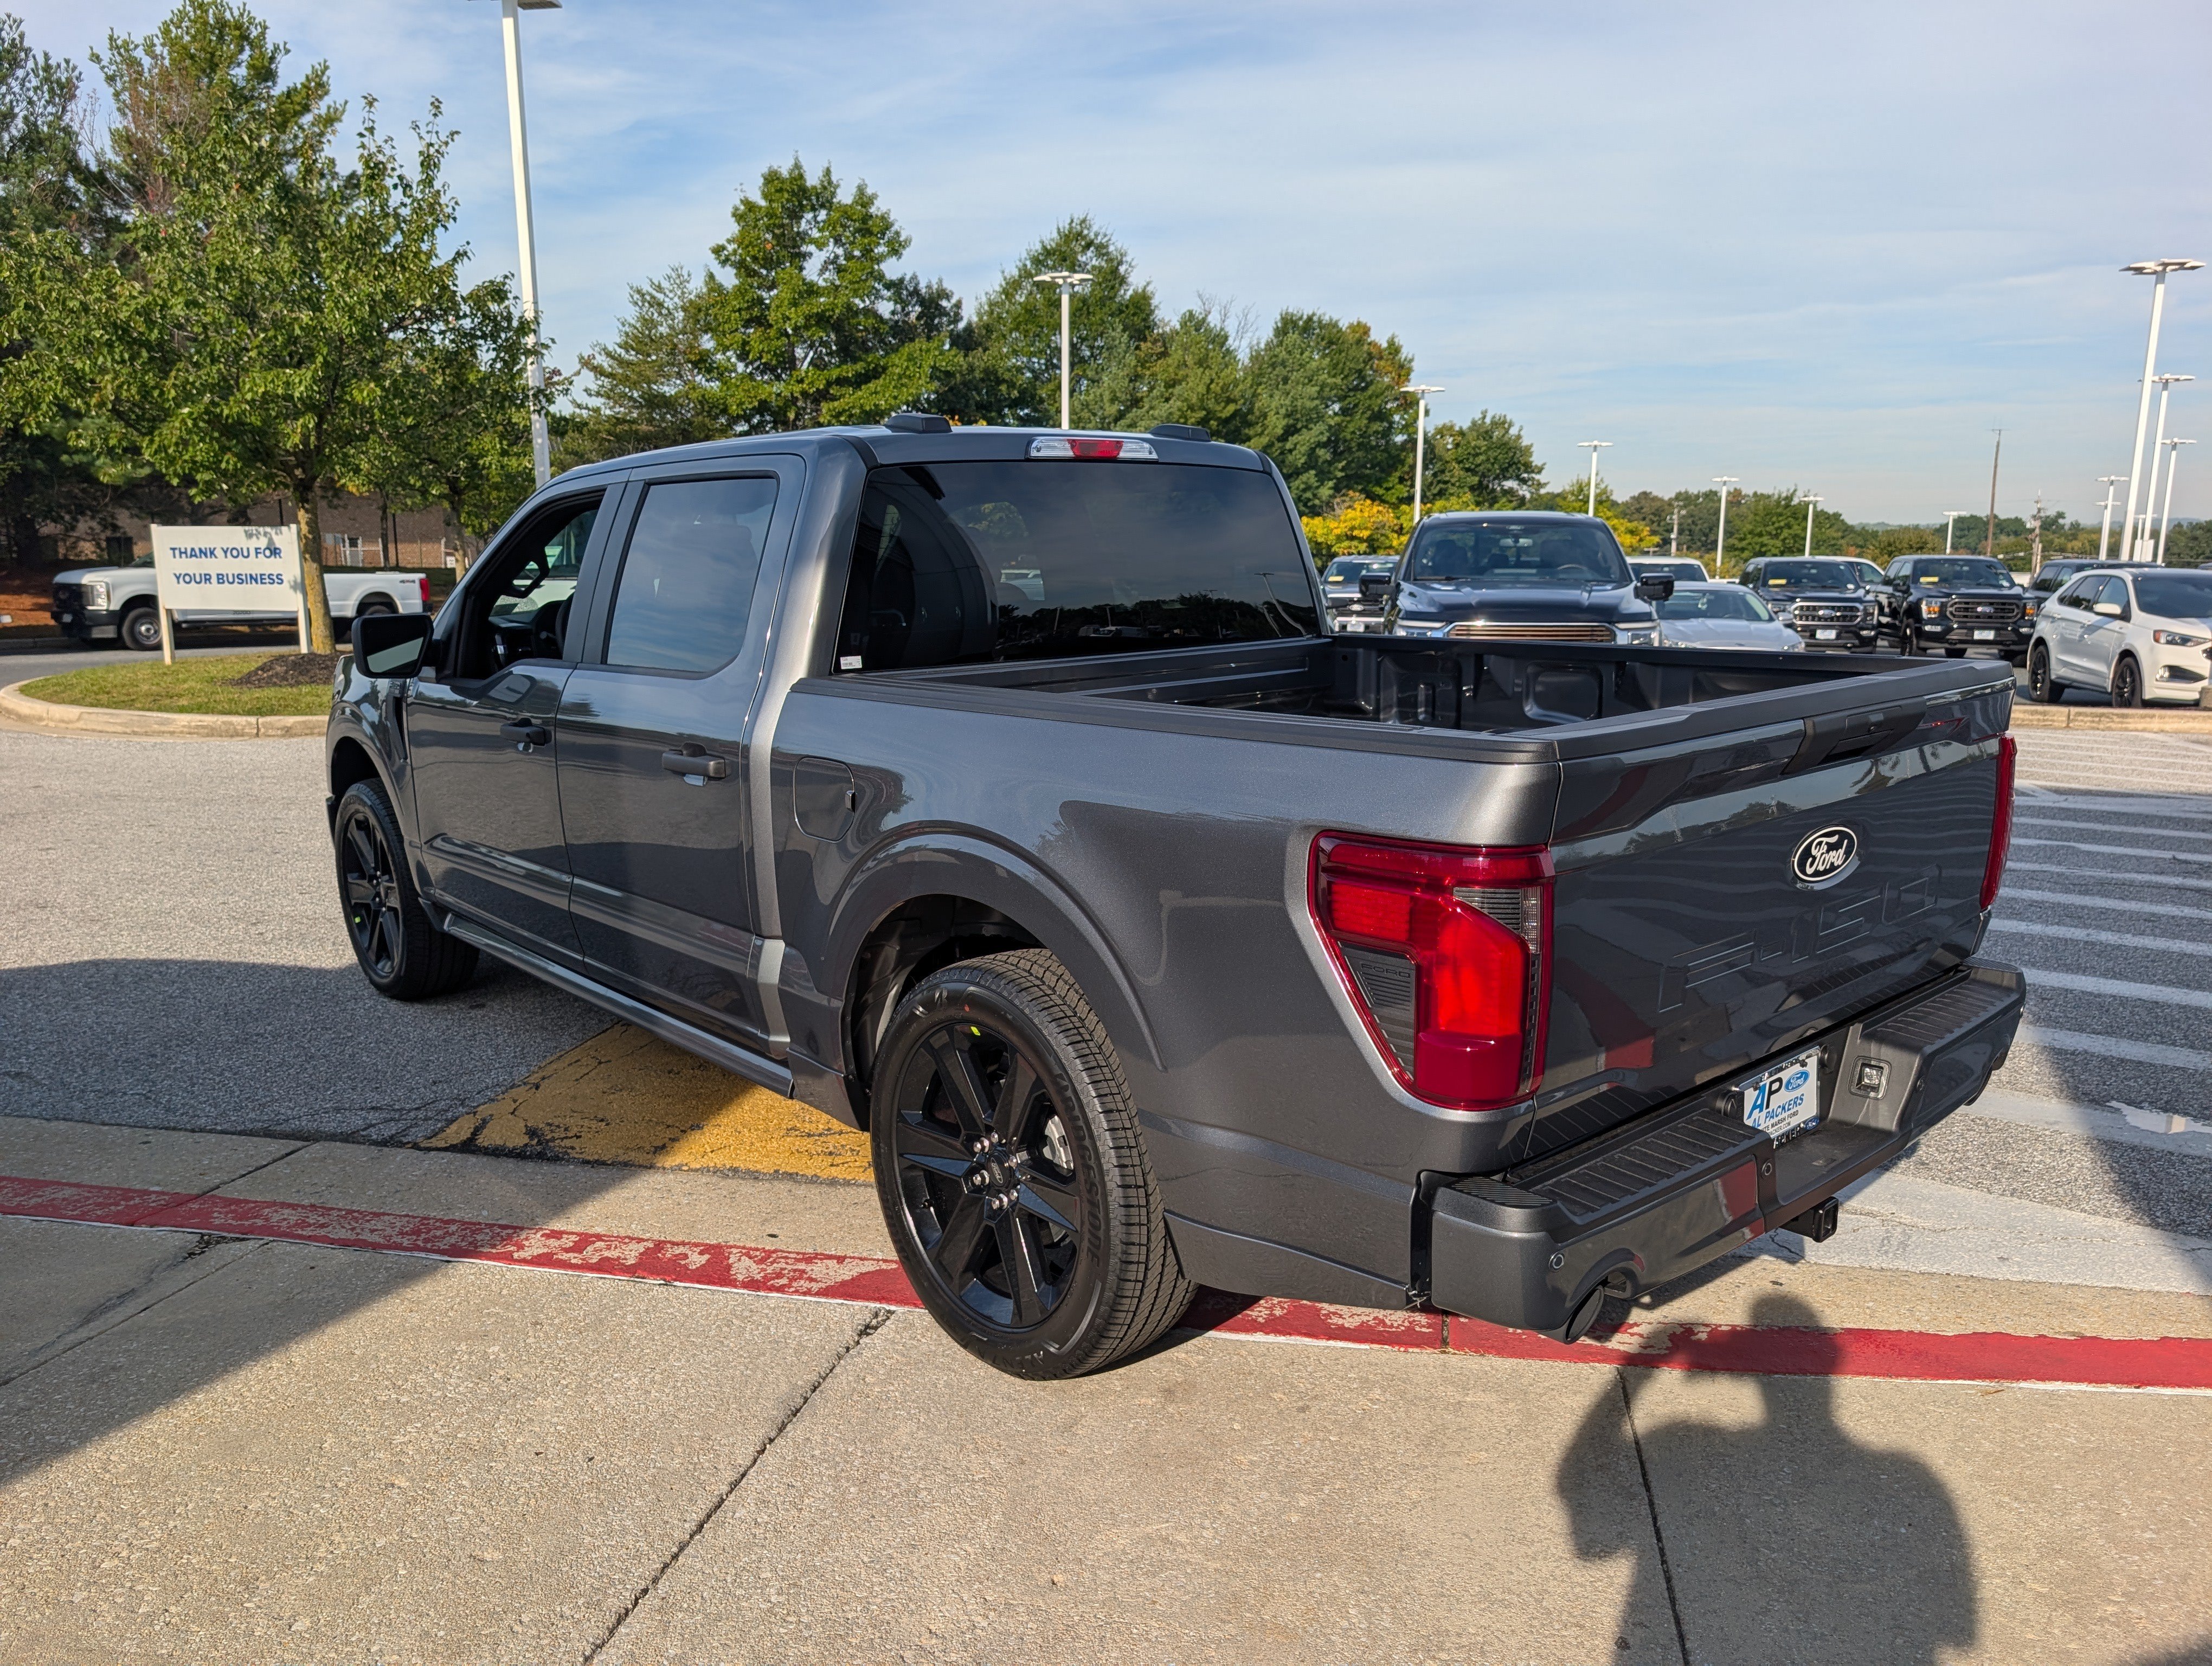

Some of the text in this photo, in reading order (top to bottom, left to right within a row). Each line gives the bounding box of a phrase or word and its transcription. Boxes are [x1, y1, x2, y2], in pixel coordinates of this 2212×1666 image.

[170, 547, 282, 559] THANK YOU FOR
[173, 573, 284, 585] YOUR BUSINESS
[1805, 834, 1848, 875] Ford
[1360, 963, 1411, 978] FORD
[1789, 1073, 1805, 1090] Ford
[1751, 1115, 1762, 1129] AL
[1764, 1093, 1805, 1124] PACKERS
[1771, 1116, 1786, 1129] MARSH
[1787, 1110, 1799, 1121] FORD
[1054, 1071, 1103, 1270] BRIDGESTONE
